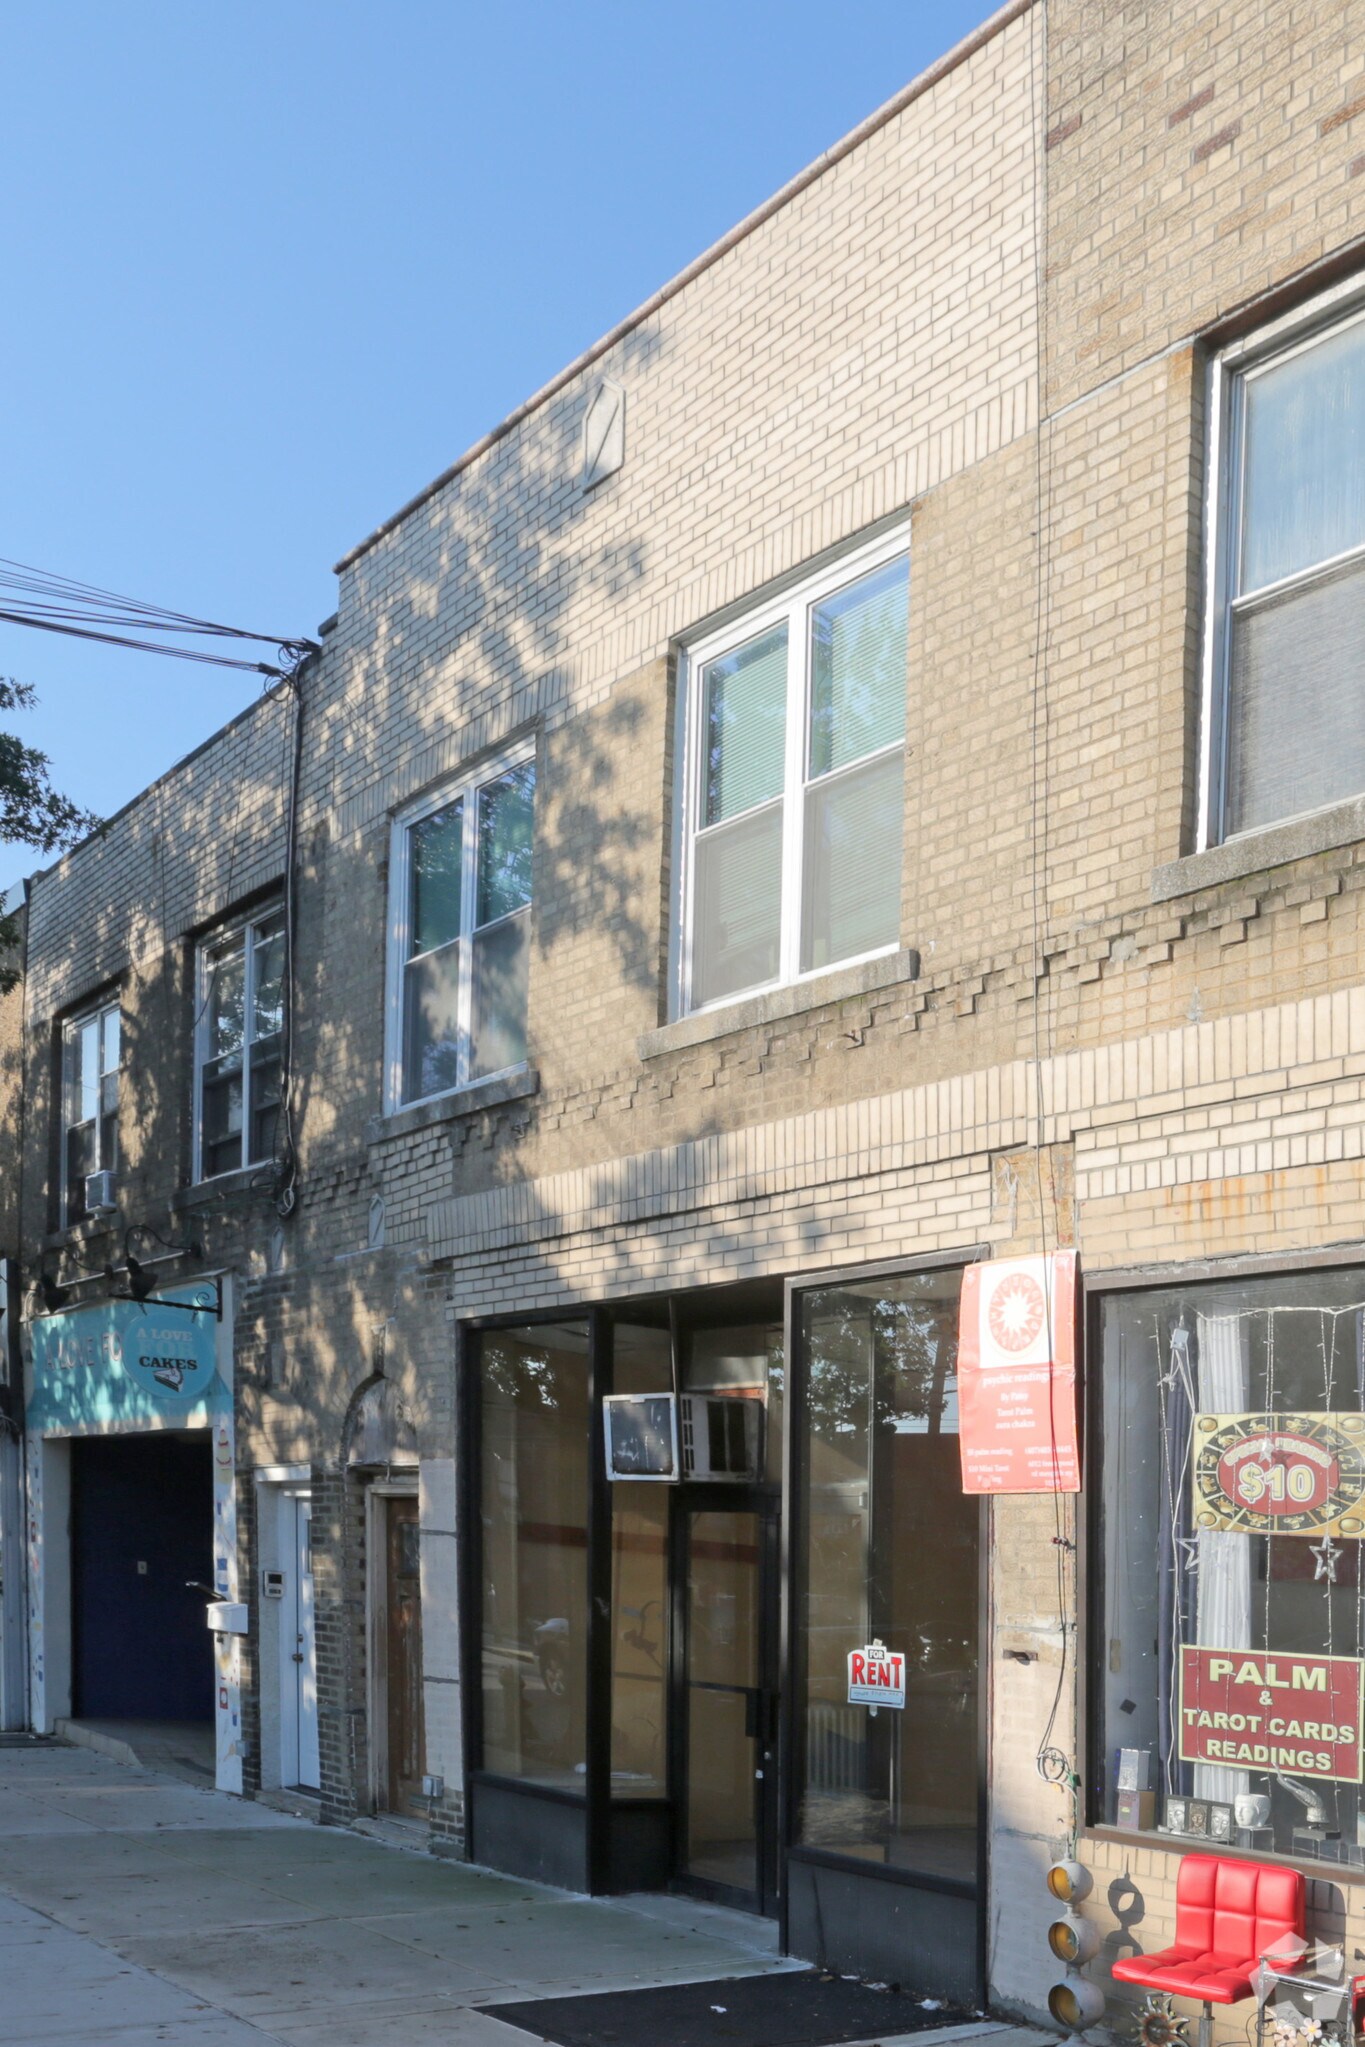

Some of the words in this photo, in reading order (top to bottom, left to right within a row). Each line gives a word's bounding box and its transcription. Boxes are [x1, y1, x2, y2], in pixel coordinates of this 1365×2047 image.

[102, 1331, 123, 1363] FO
[136, 1328, 147, 1338] A
[151, 1328, 193, 1341] LOVE
[139, 1356, 198, 1370] CAKES
[1238, 1462, 1315, 1503] $10
[869, 1650, 884, 1659] FOR
[852, 1653, 902, 1689] RENT
[1209, 1658, 1326, 1692] PALM
[1259, 1690, 1273, 1706] &
[1183, 1708, 1262, 1733] TAROT
[1269, 1718, 1355, 1744] CARDS
[1206, 1739, 1332, 1771] READINGS
